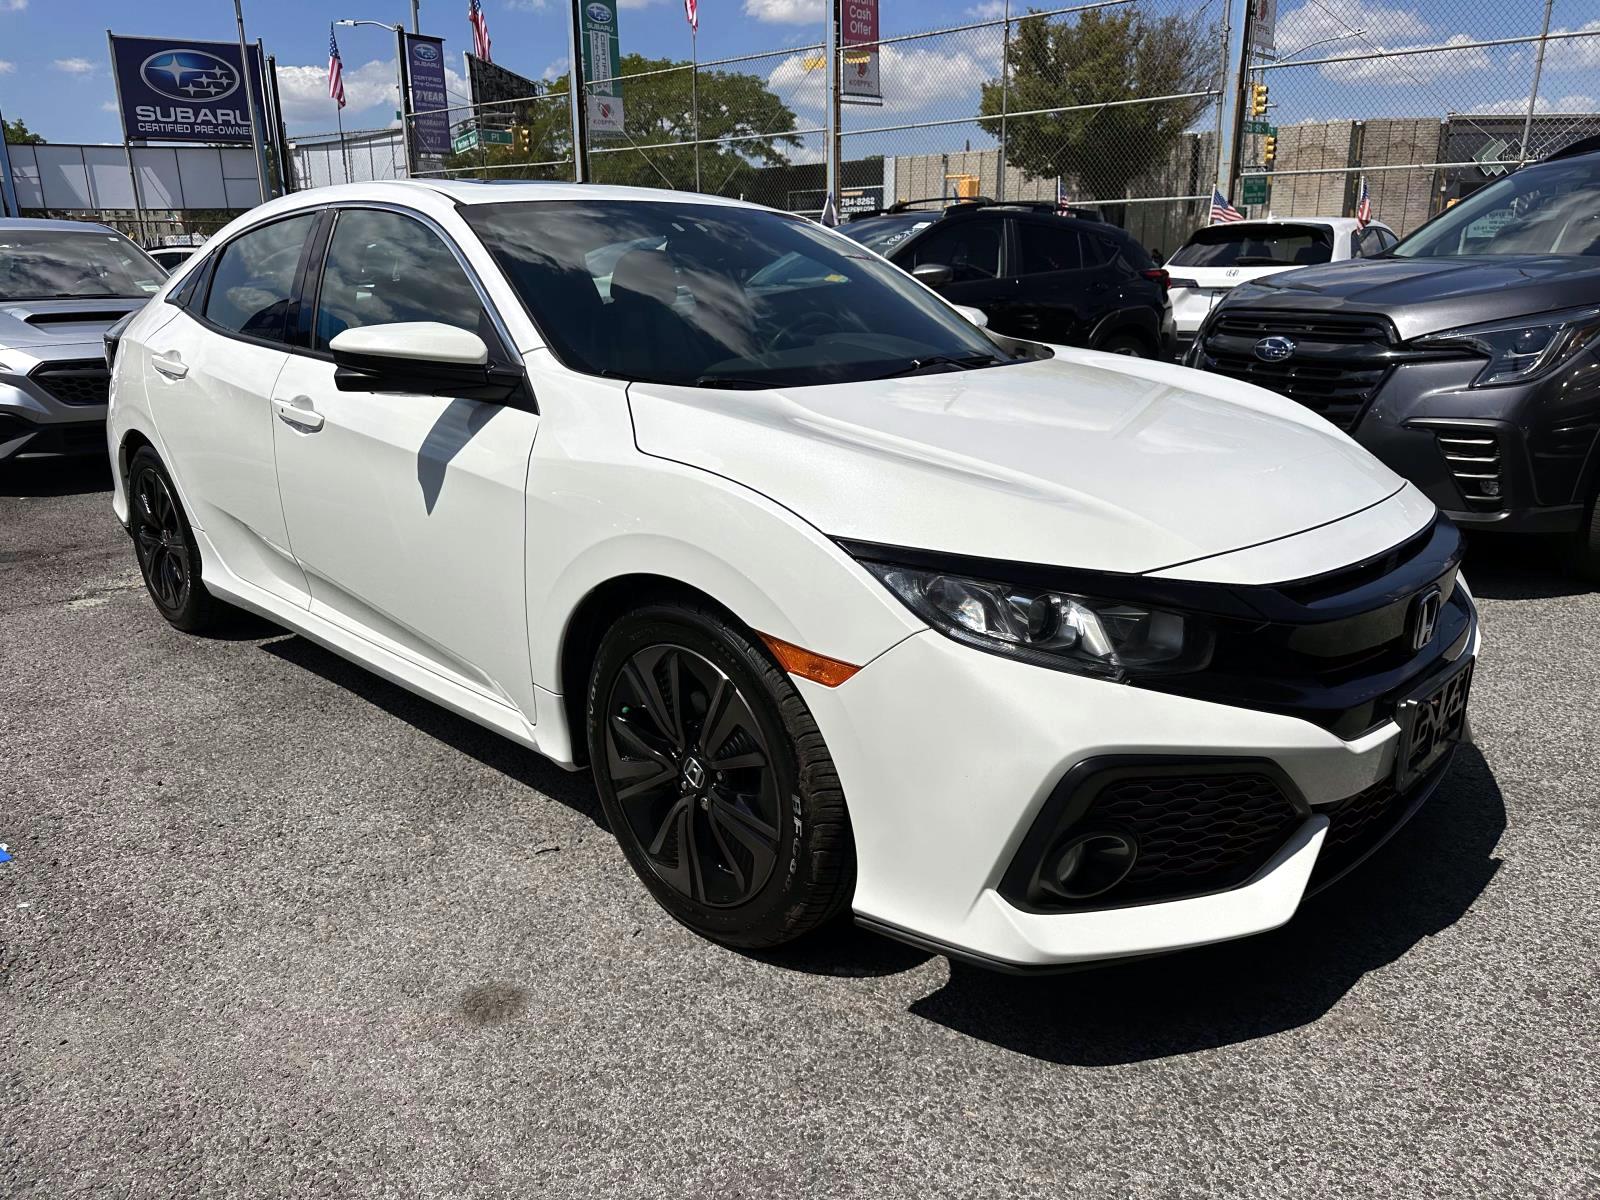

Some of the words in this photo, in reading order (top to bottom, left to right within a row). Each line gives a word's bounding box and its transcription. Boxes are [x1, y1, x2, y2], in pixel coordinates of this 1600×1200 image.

[849, 6, 871, 20] Cash
[586, 22, 614, 32] SUBARU
[850, 21, 871, 35] Offer
[138, 122, 191, 133] CERTIFIED
